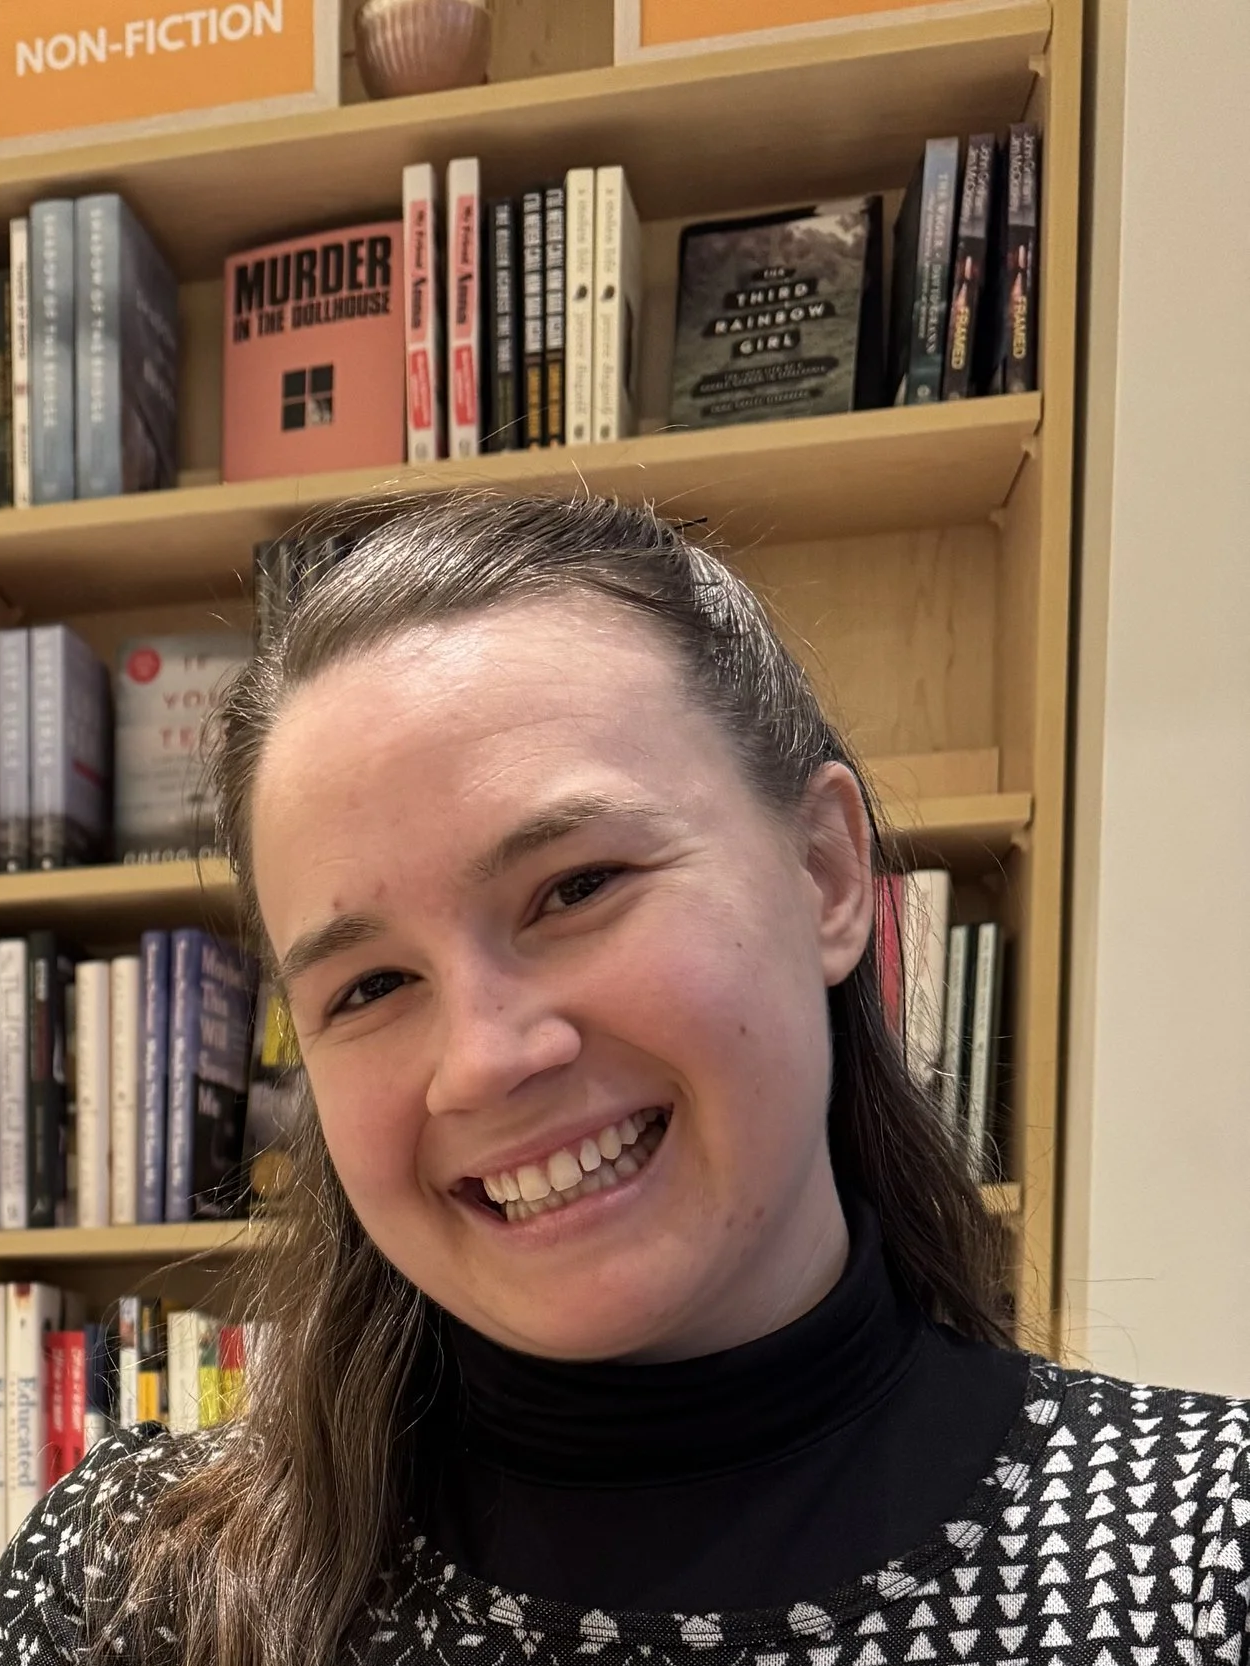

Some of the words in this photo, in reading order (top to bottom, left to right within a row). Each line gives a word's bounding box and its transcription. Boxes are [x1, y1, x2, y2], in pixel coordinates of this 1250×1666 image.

[14, 2, 284, 77] NON-FICTION
[234, 235, 392, 316] MURDER
[736, 283, 810, 307] THIRD
[233, 317, 250, 344] IN
[257, 308, 285, 338] THE
[290, 290, 390, 329] DOLLHOUSE
[714, 302, 825, 335] RAINBOW
[739, 333, 794, 355] GIRL
[951, 305, 969, 370] FRAMED
[1011, 295, 1028, 359] FRAMED
[17, 1375, 39, 1488] Educated
